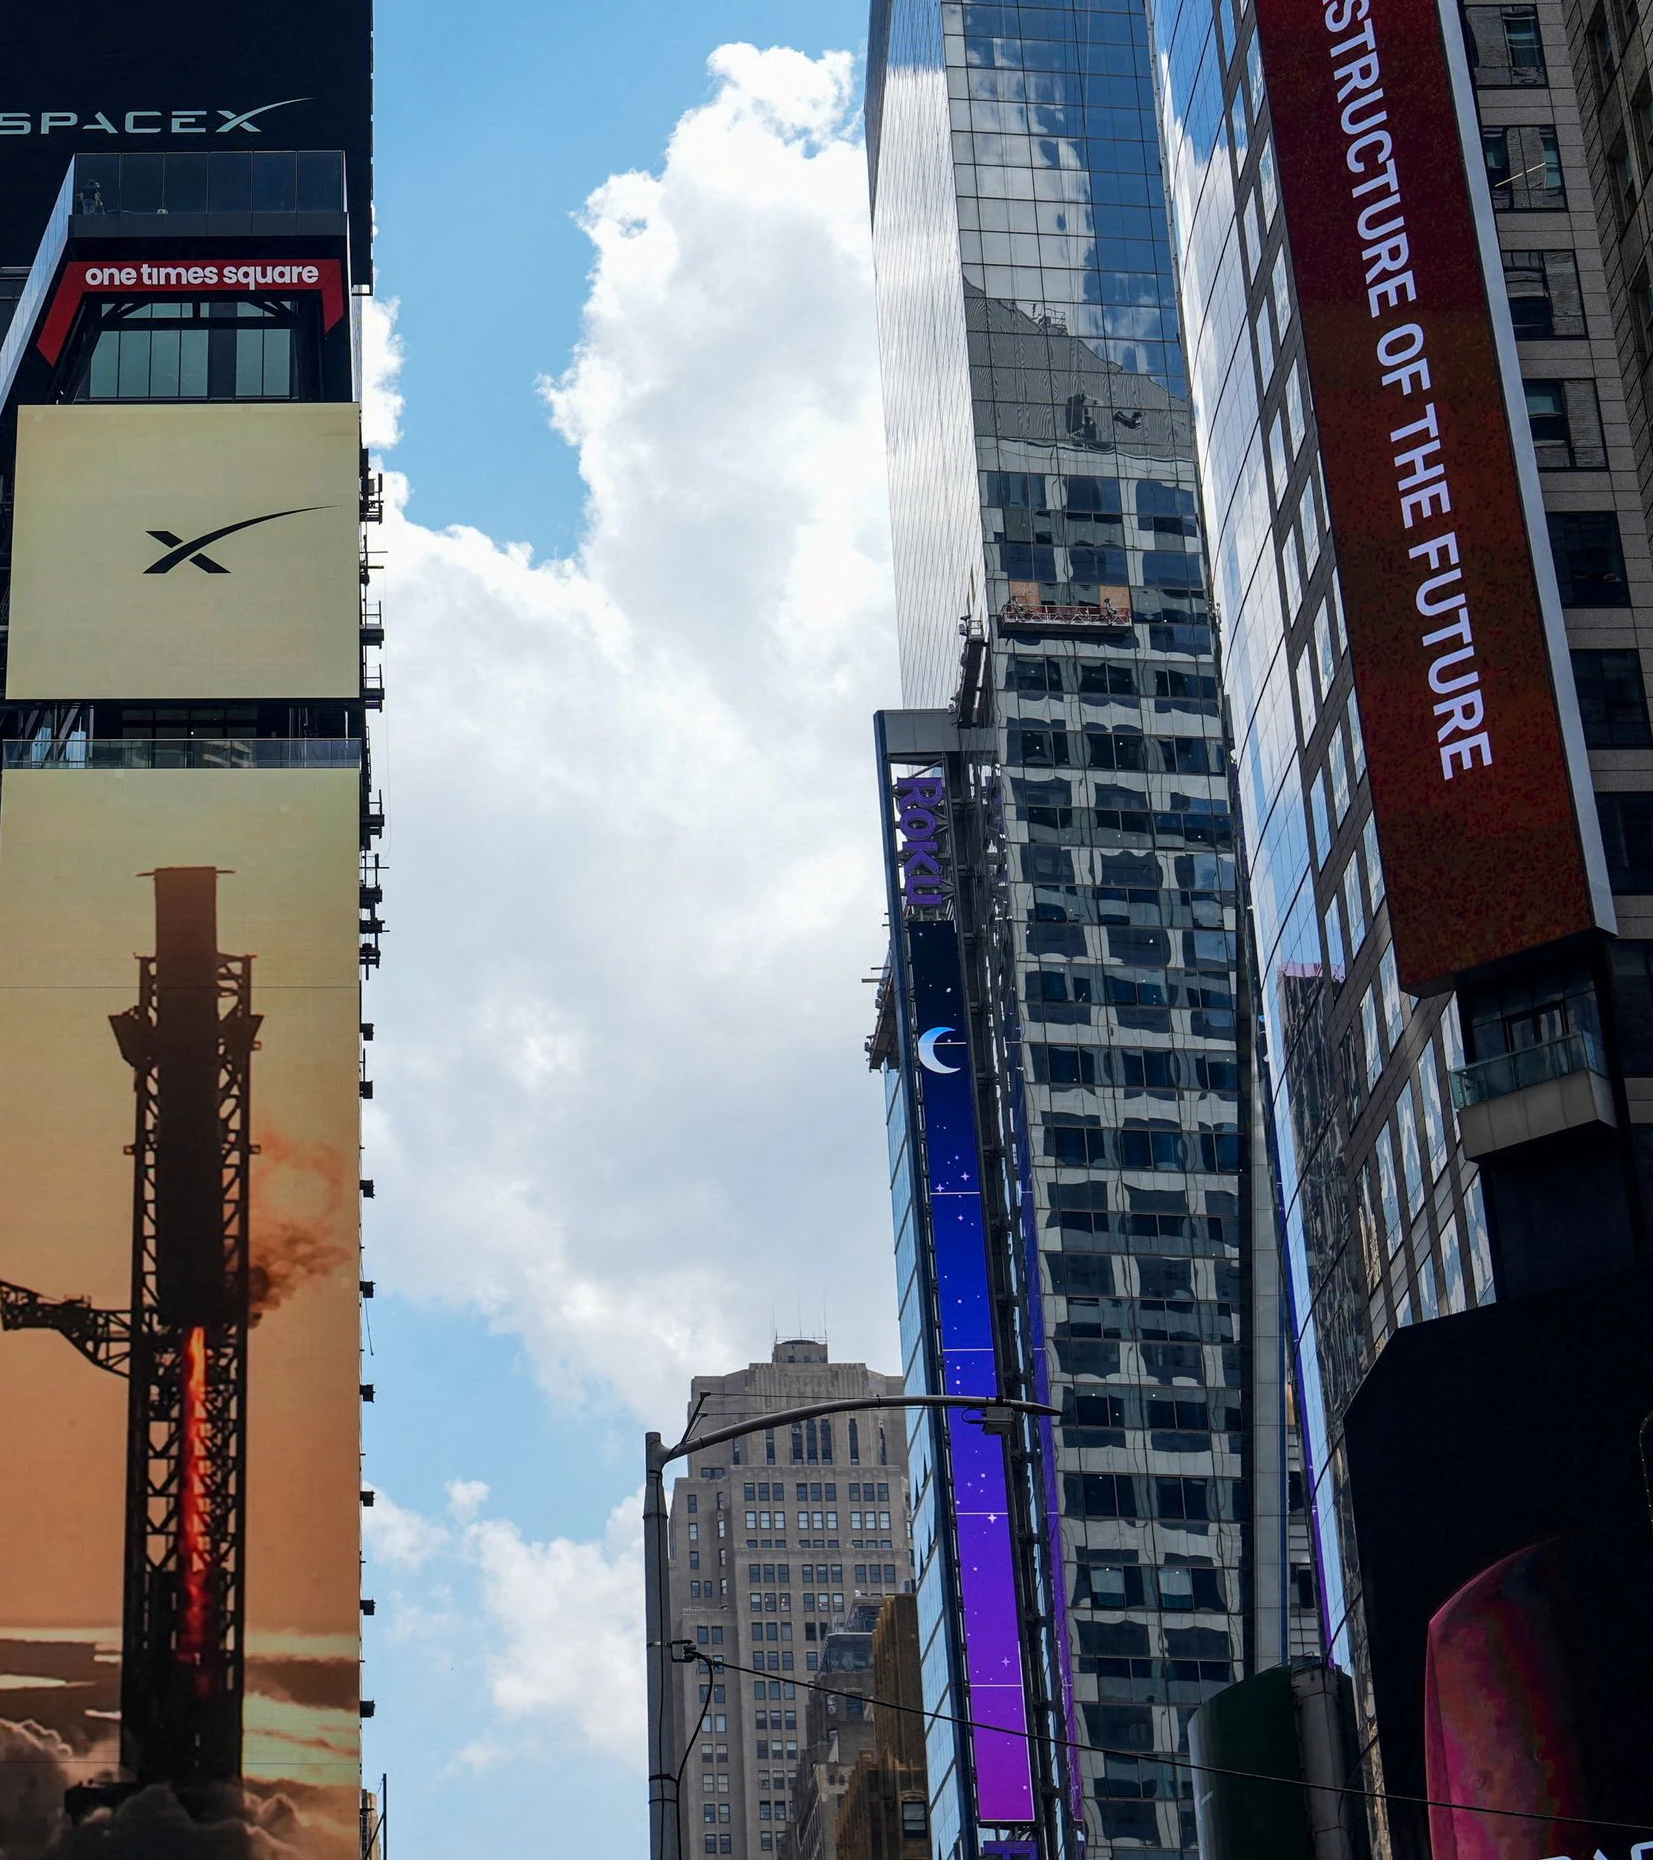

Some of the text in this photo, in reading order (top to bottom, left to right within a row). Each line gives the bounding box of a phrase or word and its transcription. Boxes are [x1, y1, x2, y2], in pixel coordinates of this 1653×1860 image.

[85, 263, 319, 291] one times square
[1323, 0, 1493, 781] STRUCTURE OF THE FUTURE
